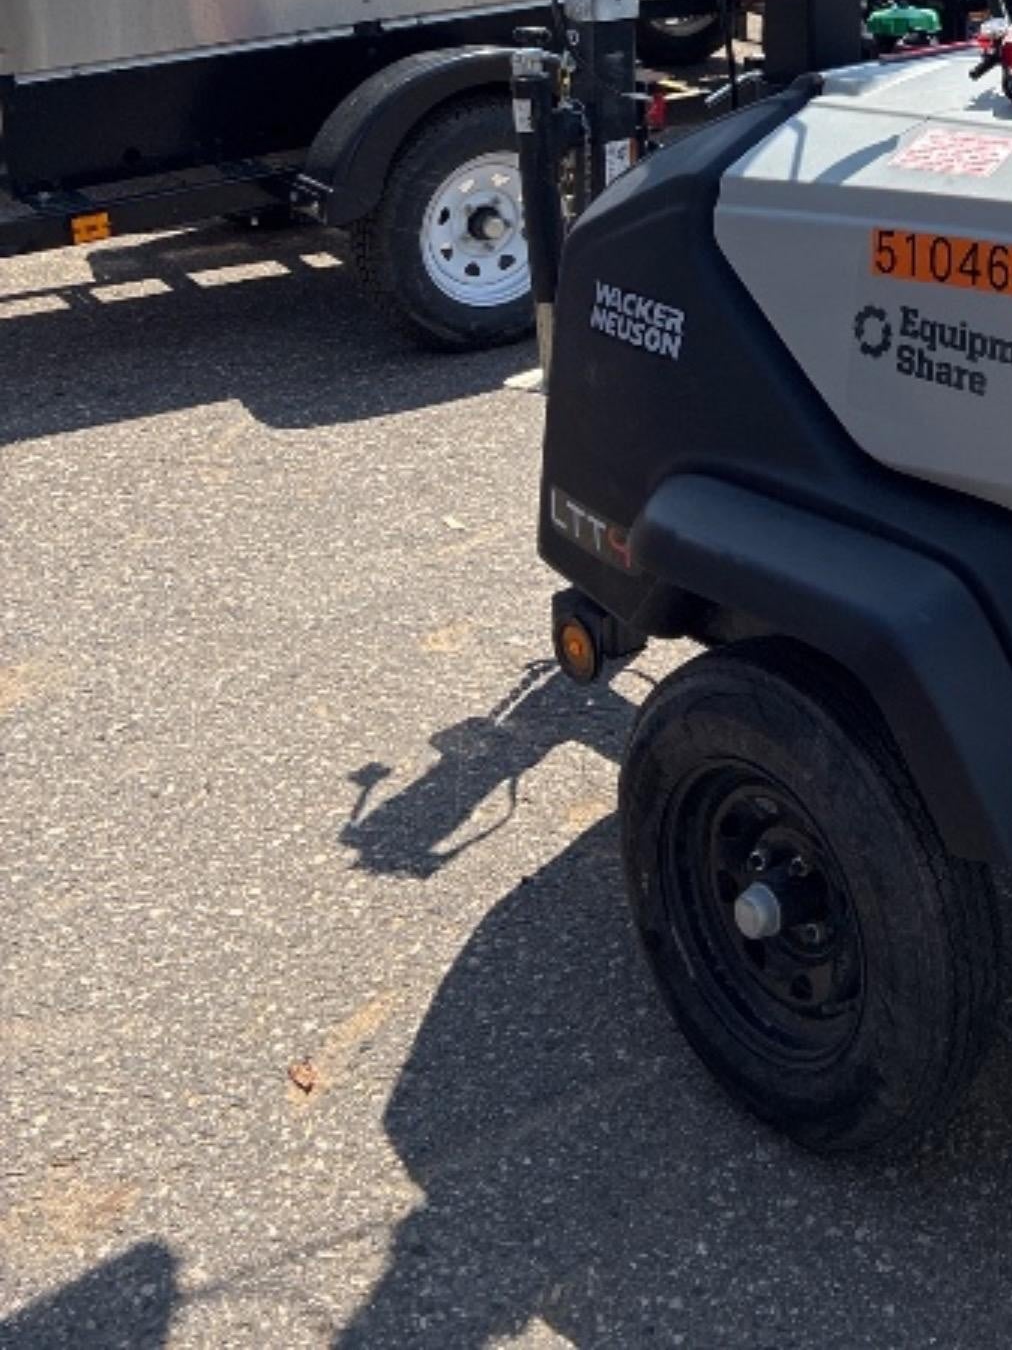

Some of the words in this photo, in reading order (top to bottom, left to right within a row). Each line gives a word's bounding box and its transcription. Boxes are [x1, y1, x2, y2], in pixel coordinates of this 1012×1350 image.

[590, 305, 683, 361] NEUSON
[595, 278, 685, 336] WACKER
[896, 344, 987, 397] Share
